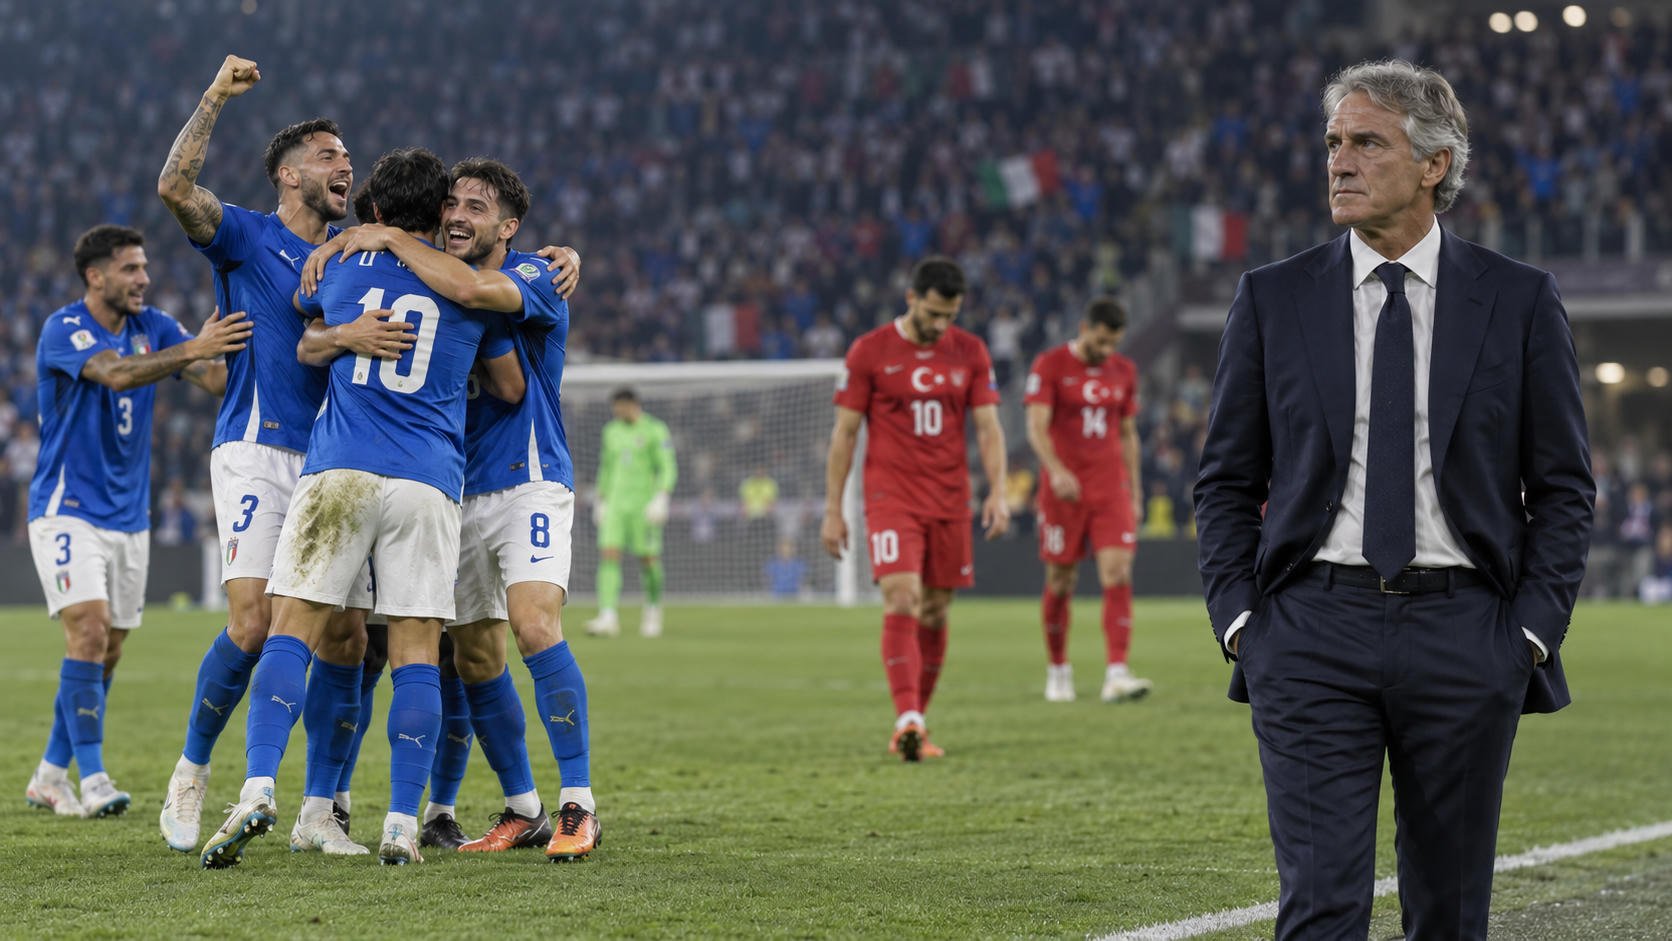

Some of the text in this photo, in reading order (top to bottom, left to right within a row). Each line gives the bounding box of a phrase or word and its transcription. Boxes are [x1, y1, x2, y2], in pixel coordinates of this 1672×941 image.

[352, 287, 441, 394] 10
[118, 397, 132, 435] 3
[910, 399, 943, 436] 10
[1080, 405, 1107, 439] 14
[232, 494, 260, 533] 3
[530, 512, 550, 549] 8
[55, 532, 71, 566] 3
[871, 528, 899, 567] 10
